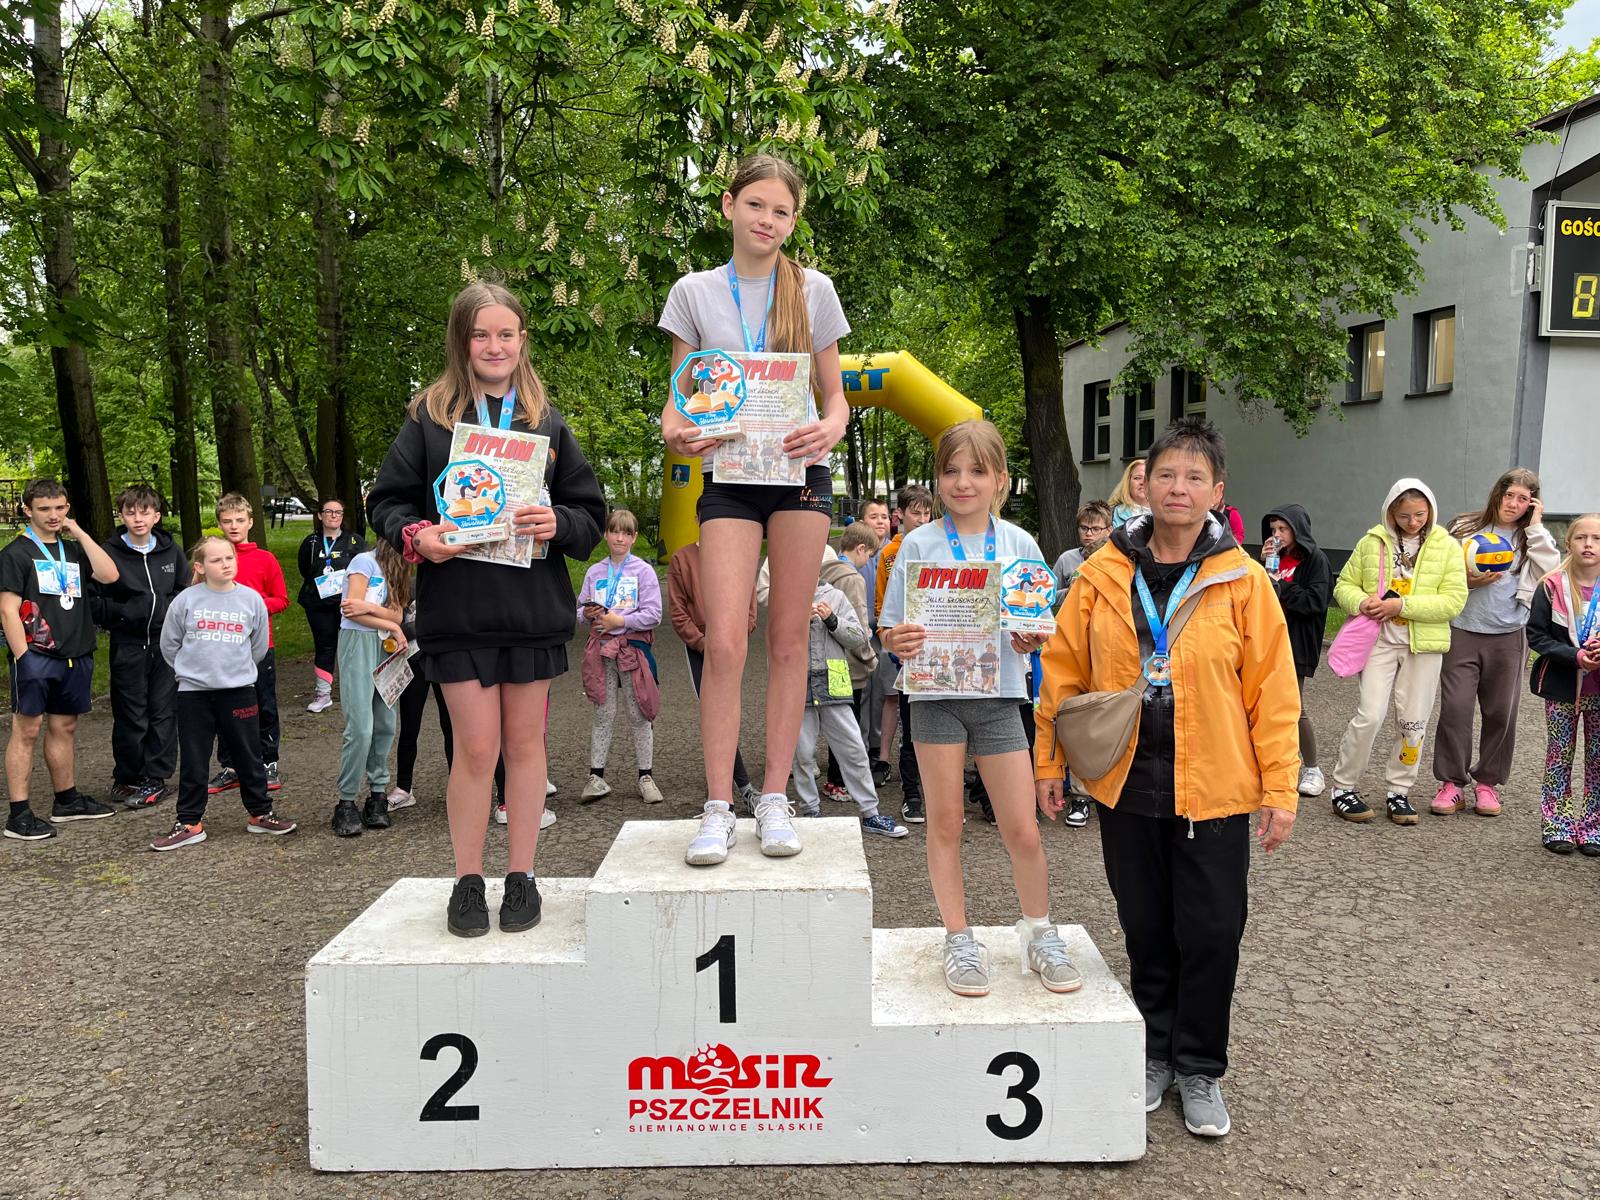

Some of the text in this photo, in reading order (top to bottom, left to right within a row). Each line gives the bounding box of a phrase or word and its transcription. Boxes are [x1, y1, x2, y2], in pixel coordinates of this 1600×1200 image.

[738, 358, 797, 381] YPLOM
[463, 432, 537, 463] DYPLOM
[917, 567, 989, 590] DYPLOM
[193, 608, 247, 623] street
[197, 619, 245, 633] dance
[695, 935, 736, 1024] 1
[419, 1033, 480, 1122] 2
[985, 1051, 1043, 1140] 3
[629, 1097, 824, 1120] PSZCZELNIK
[628, 1123, 748, 1133] SIEMIANOWICE
